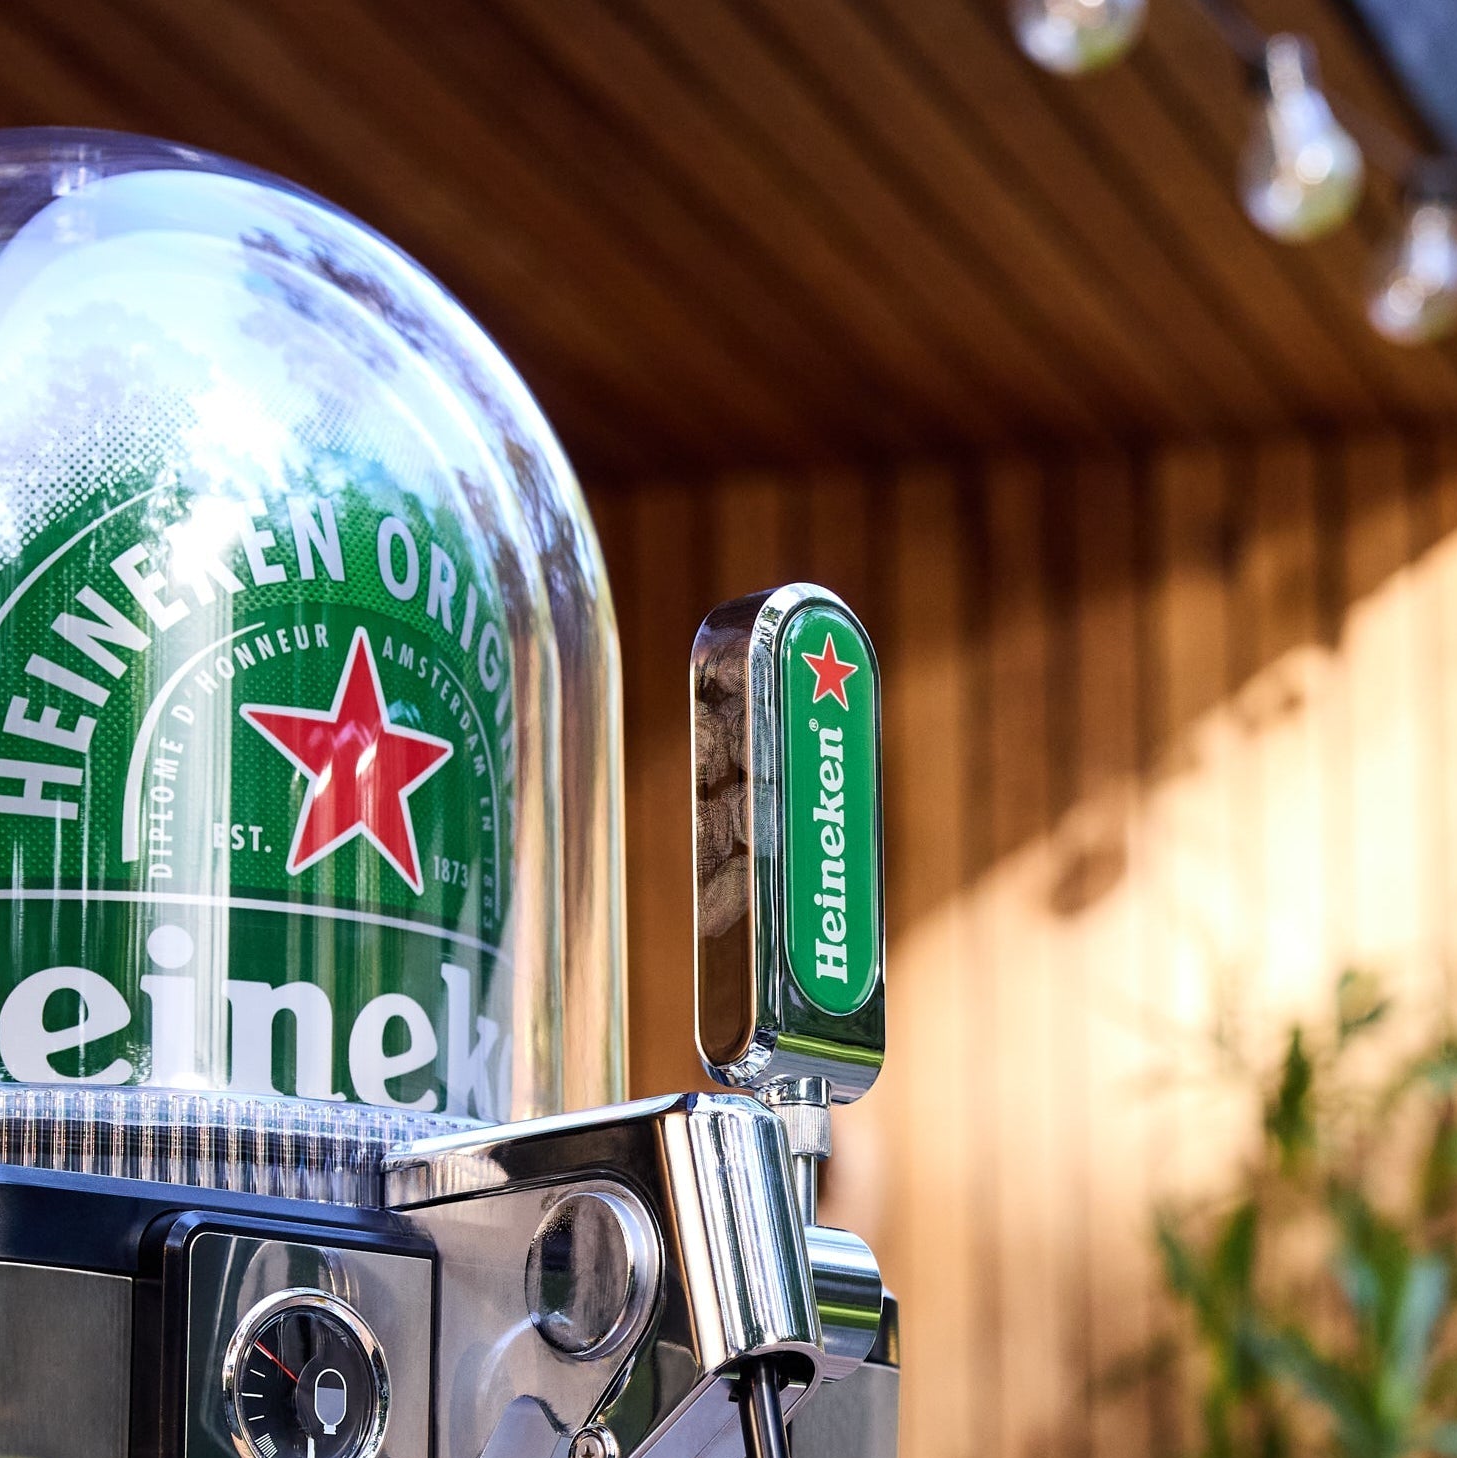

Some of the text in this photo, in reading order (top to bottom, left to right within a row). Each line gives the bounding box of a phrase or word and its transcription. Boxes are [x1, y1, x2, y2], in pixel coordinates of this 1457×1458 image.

[149, 736, 184, 879] DIPLOME
[382, 635, 486, 777] AMSTERDAM
[480, 796, 492, 832] EN
[213, 822, 469, 889] EST. 1873
